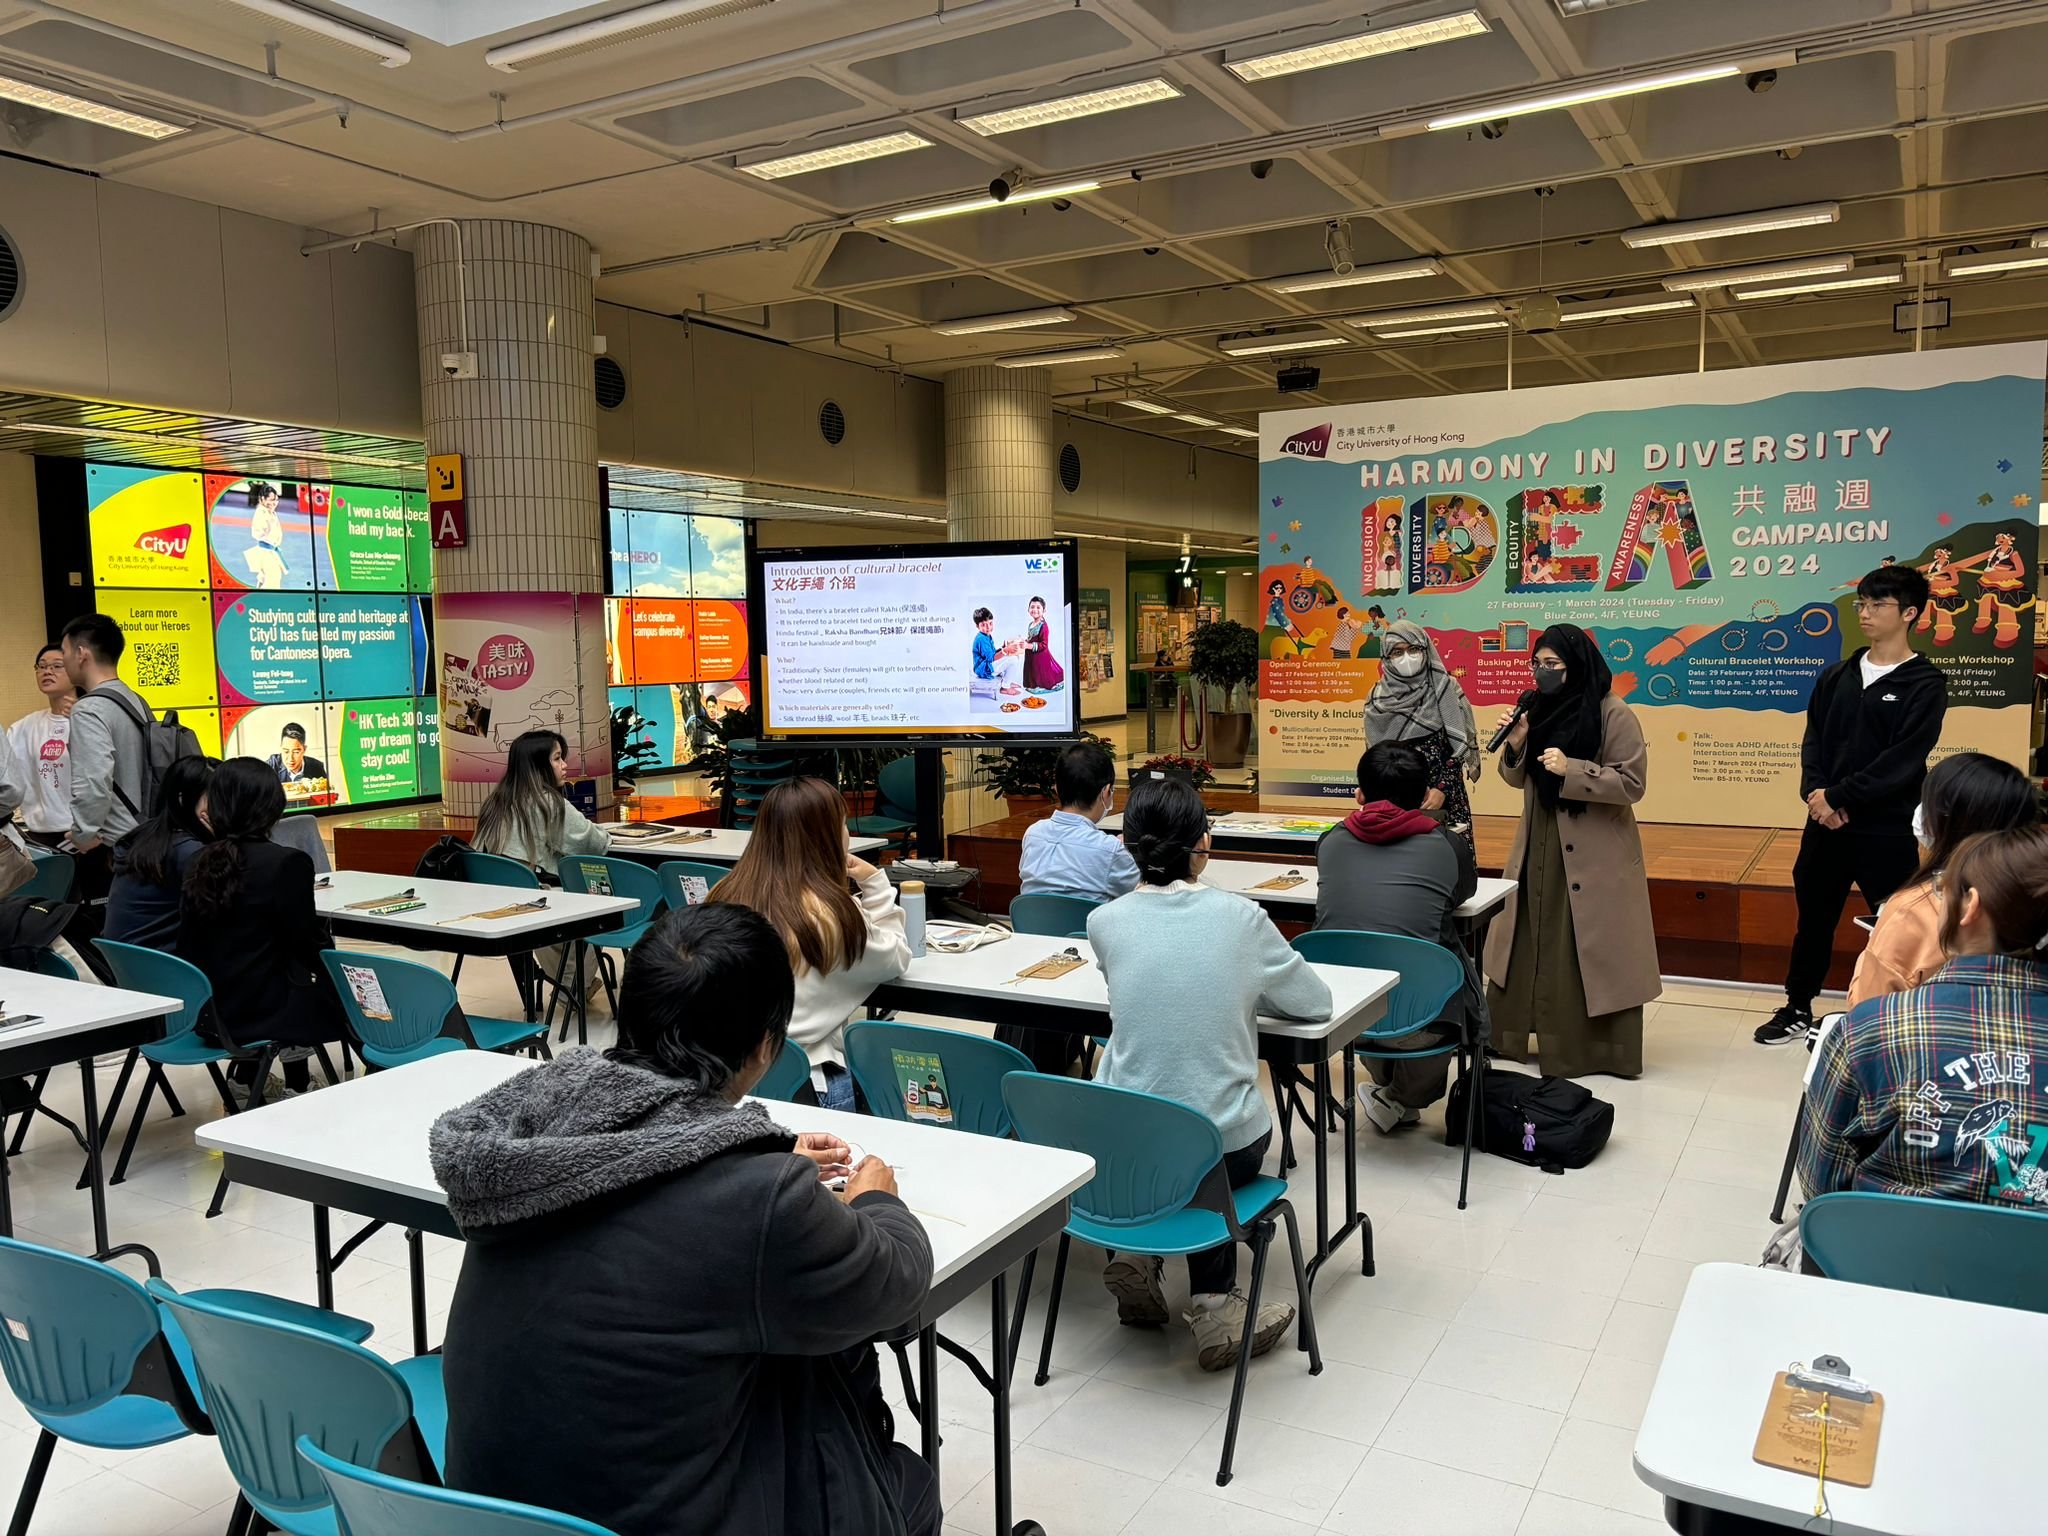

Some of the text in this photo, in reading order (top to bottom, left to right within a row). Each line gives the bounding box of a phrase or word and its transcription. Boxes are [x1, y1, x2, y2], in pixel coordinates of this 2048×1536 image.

[1337, 424, 1396, 437] 香港城市大學
[1286, 439, 1322, 456] CityU
[1336, 432, 1465, 451] City University of Hong Kong
[1361, 426, 1891, 488] HARMONY IN DIVERSITY
[353, 507, 373, 519] won
[375, 508, 381, 519] a
[382, 505, 403, 520] Gold
[348, 521, 416, 540] had my back.
[437, 510, 460, 540] A
[1611, 493, 1645, 580] AWARENESS
[1732, 520, 1889, 548] CAMPAIGN
[140, 537, 187, 556] CityU
[1364, 515, 1374, 587] INCLUSION
[1411, 514, 1422, 584] DIVERSITY
[1508, 519, 1519, 570] EQUITY
[623, 552, 629, 562] a
[770, 561, 942, 577] Introduction of cultural bracelet
[1730, 554, 1820, 577] 2024
[771, 576, 856, 591] 文化手繩 介紹
[1487, 602, 1498, 610] 27
[1501, 600, 1546, 610] February
[1565, 598, 1597, 607] March
[1600, 598, 1624, 606] 2024
[1627, 597, 1675, 608] (Tuesday
[1685, 595, 1725, 606] Friday)
[130, 607, 178, 618] Learn more
[249, 608, 409, 627] Studying culture and heritage at
[648, 612, 676, 623] celebrate
[1544, 610, 1660, 620] Blue Zone, 4/F, YEUNG
[120, 620, 190, 631] about our Heroes
[634, 625, 685, 639] campus diversity!
[250, 627, 396, 645] CityU has fuelled my passion
[251, 645, 353, 662] for Cantonese Opera.
[488, 641, 526, 662] 美味
[1269, 661, 1341, 669] Opening Ceremony
[1477, 658, 1511, 668] Busking
[1689, 656, 1825, 667] Cultural Bracelet Workshop
[1925, 655, 2015, 665] ance Workshop
[481, 662, 528, 679] TASTY!
[823, 666, 841, 674] Sister
[1720, 669, 1753, 677] February
[1775, 669, 1817, 677] (Thursday)
[1963, 669, 1996, 677] (Friday)
[359, 714, 375, 730] HK
[375, 712, 400, 729] Tech
[402, 711, 423, 727] 300
[1321, 709, 1330, 718] &
[1322, 726, 1359, 734] Community
[360, 736, 377, 752] my
[379, 732, 412, 747] dream
[417, 731, 427, 744] to
[361, 749, 410, 770] stay cool!
[1311, 775, 1354, 783] Organised by
[1903, 1051, 2031, 1149] OFF THE
